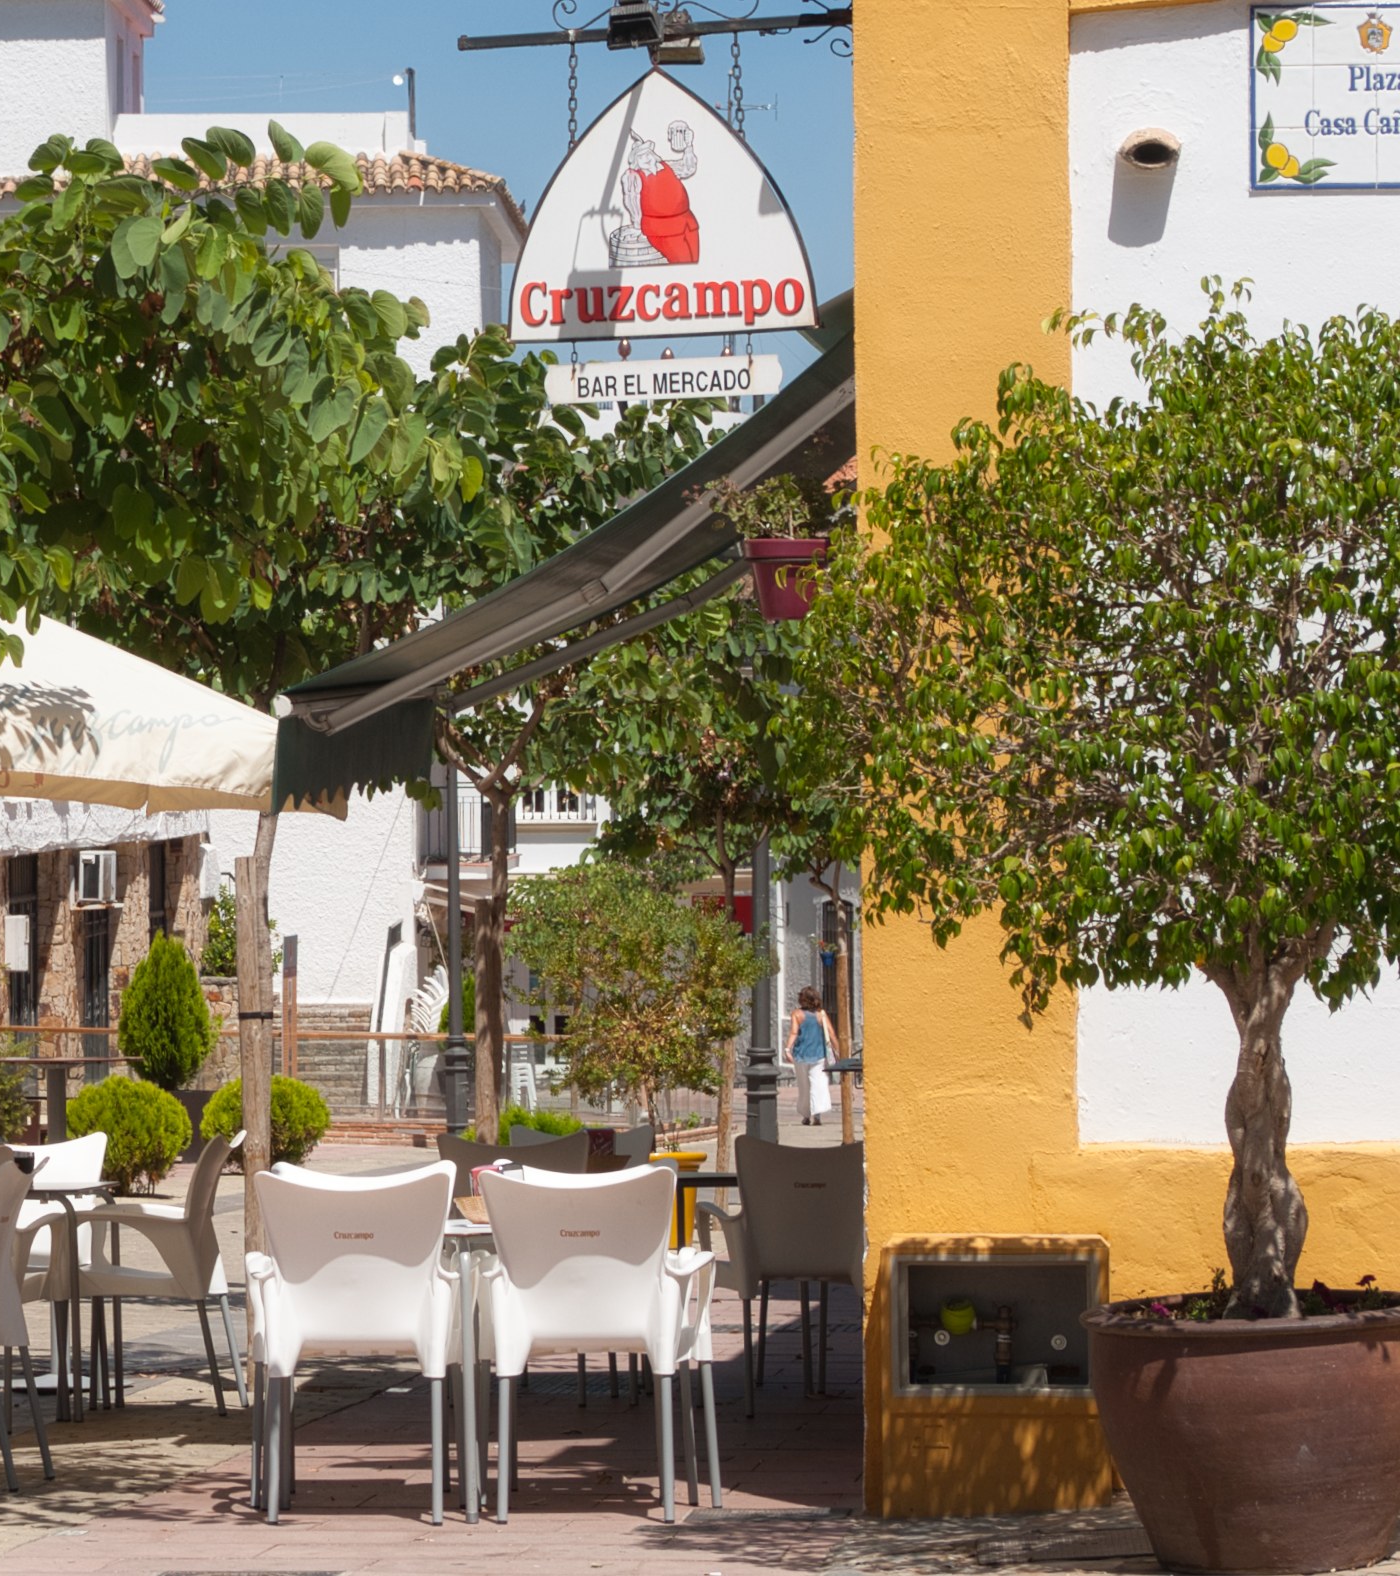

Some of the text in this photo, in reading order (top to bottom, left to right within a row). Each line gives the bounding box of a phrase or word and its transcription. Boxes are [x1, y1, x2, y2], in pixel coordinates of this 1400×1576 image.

[1348, 65, 1400, 91] Plaz
[1304, 109, 1357, 136] Casa
[520, 278, 805, 326] Cruzcampo
[577, 368, 751, 398] BAR EL MERCADO
[333, 1231, 374, 1240] Cruzcampo
[560, 1229, 601, 1238] Cruzcampo
